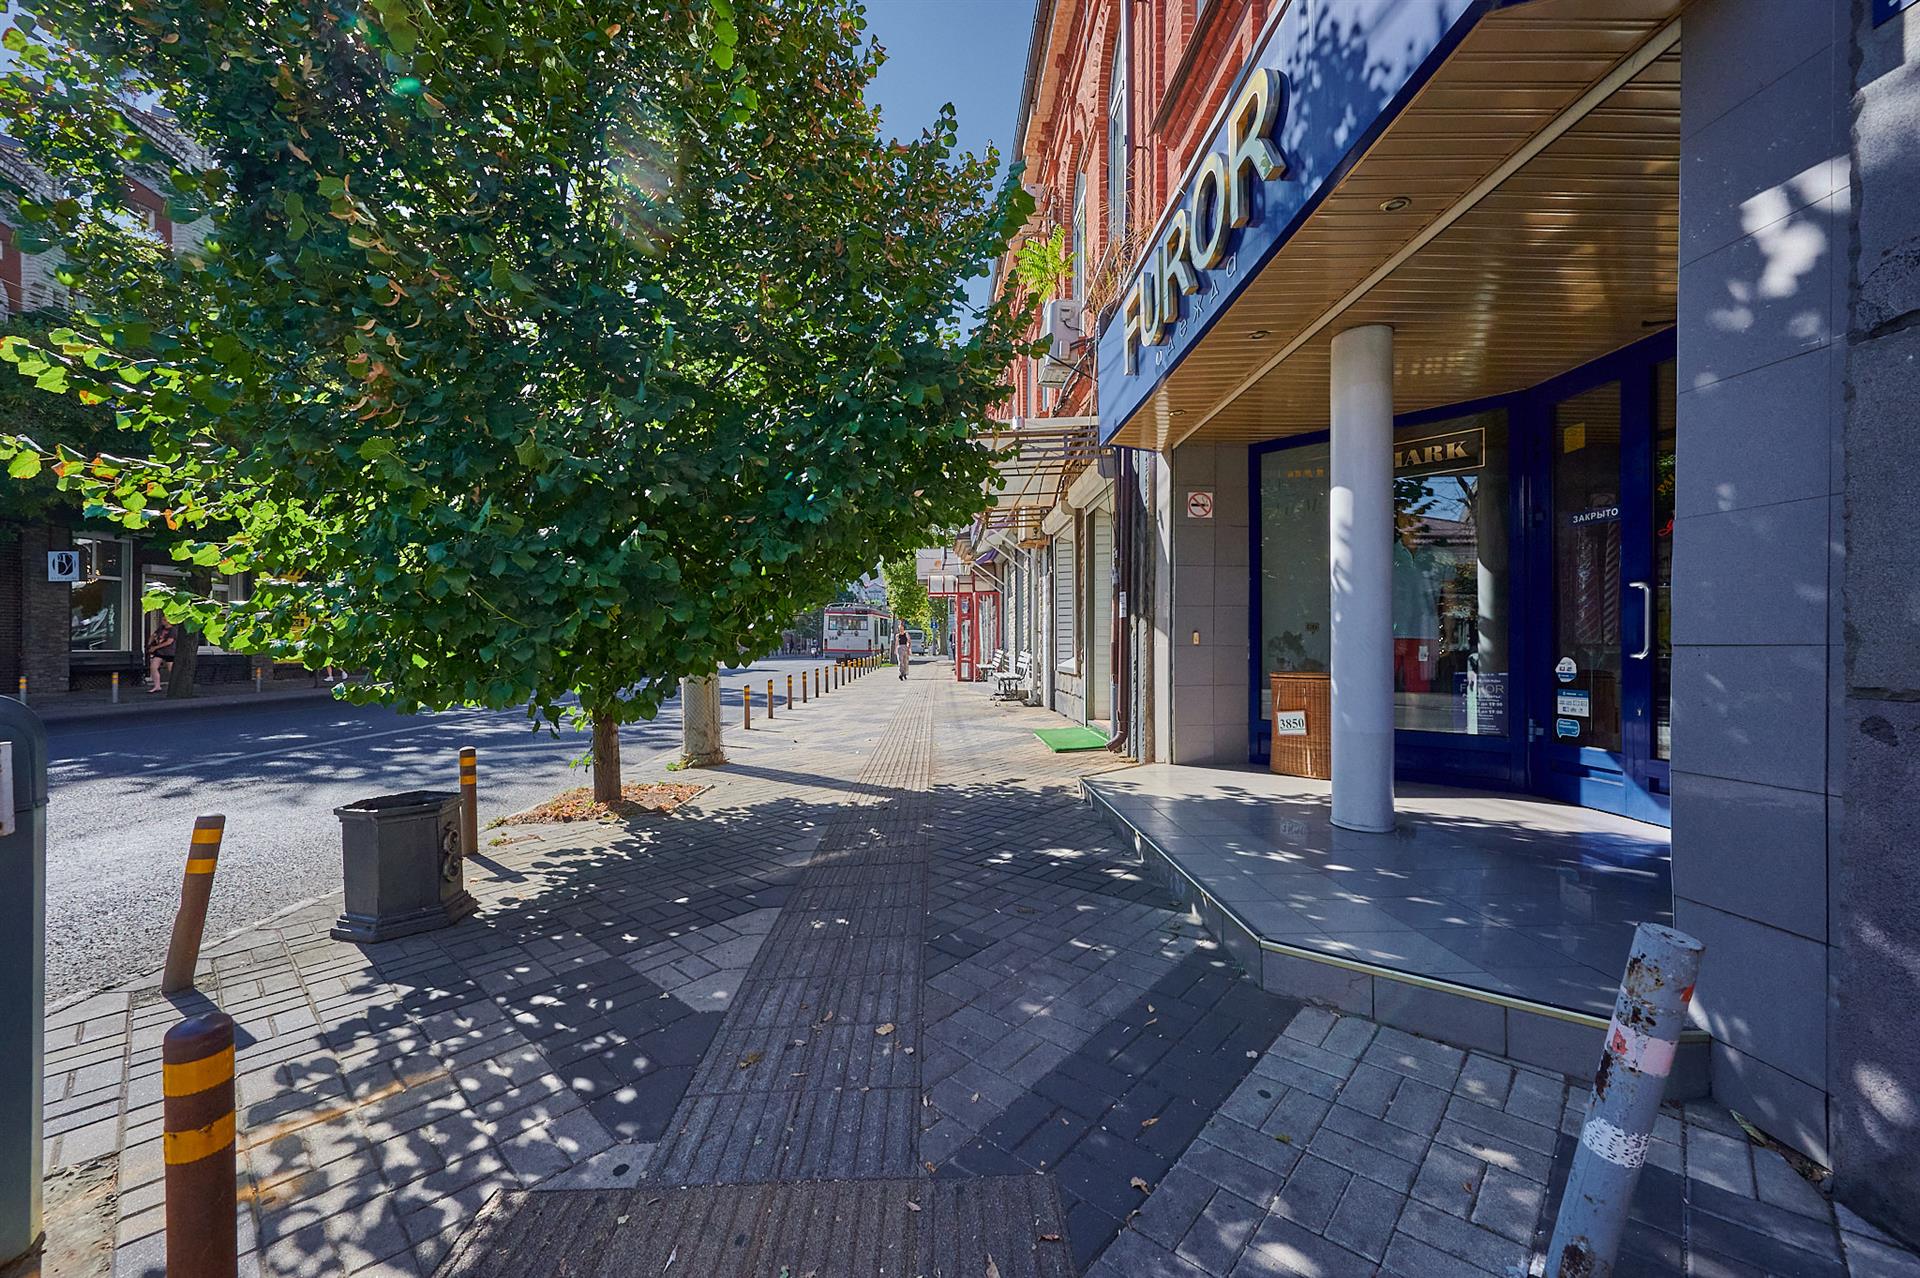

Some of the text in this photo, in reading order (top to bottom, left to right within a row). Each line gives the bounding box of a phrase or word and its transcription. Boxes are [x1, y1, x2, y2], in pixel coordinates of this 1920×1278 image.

[1124, 68, 1286, 375] FUROR
[1572, 507, 1619, 524] ЗАКРЫТО
[1460, 683, 1504, 694] FROR
[1280, 718, 1304, 730] 3850
